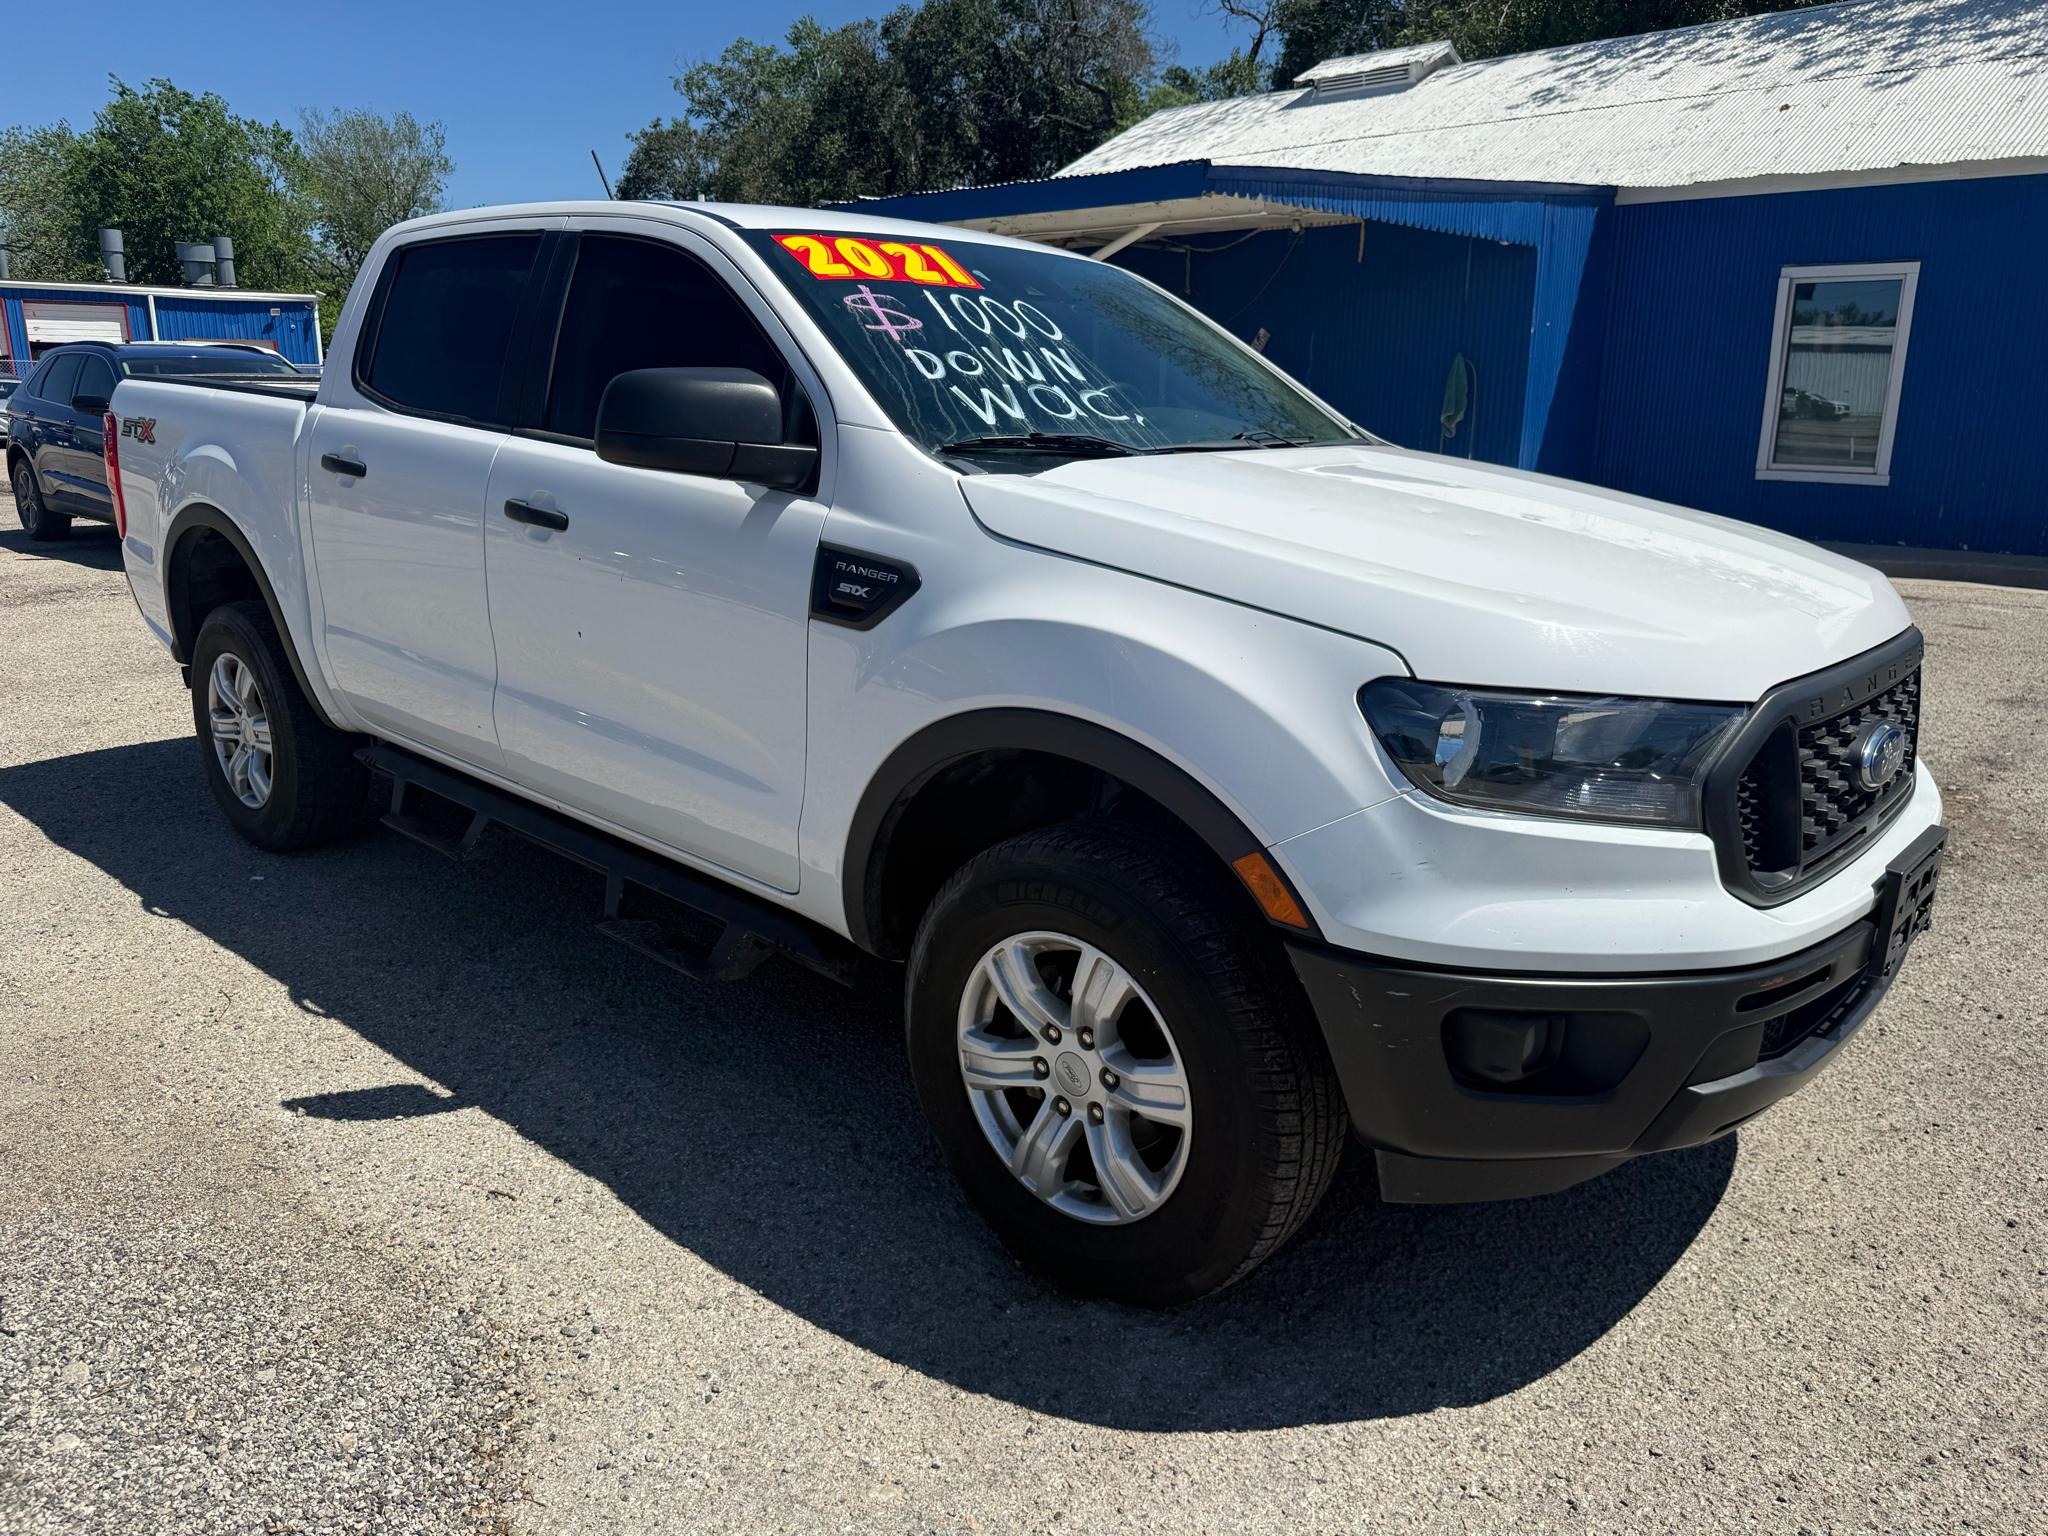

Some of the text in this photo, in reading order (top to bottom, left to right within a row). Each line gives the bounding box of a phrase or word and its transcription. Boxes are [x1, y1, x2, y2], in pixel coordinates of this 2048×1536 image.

[782, 236, 971, 286] 2021
[905, 346, 1086, 382] DOWN
[121, 416, 157, 444] STX
[836, 561, 898, 584] RANGER
[836, 582, 871, 598] STX
